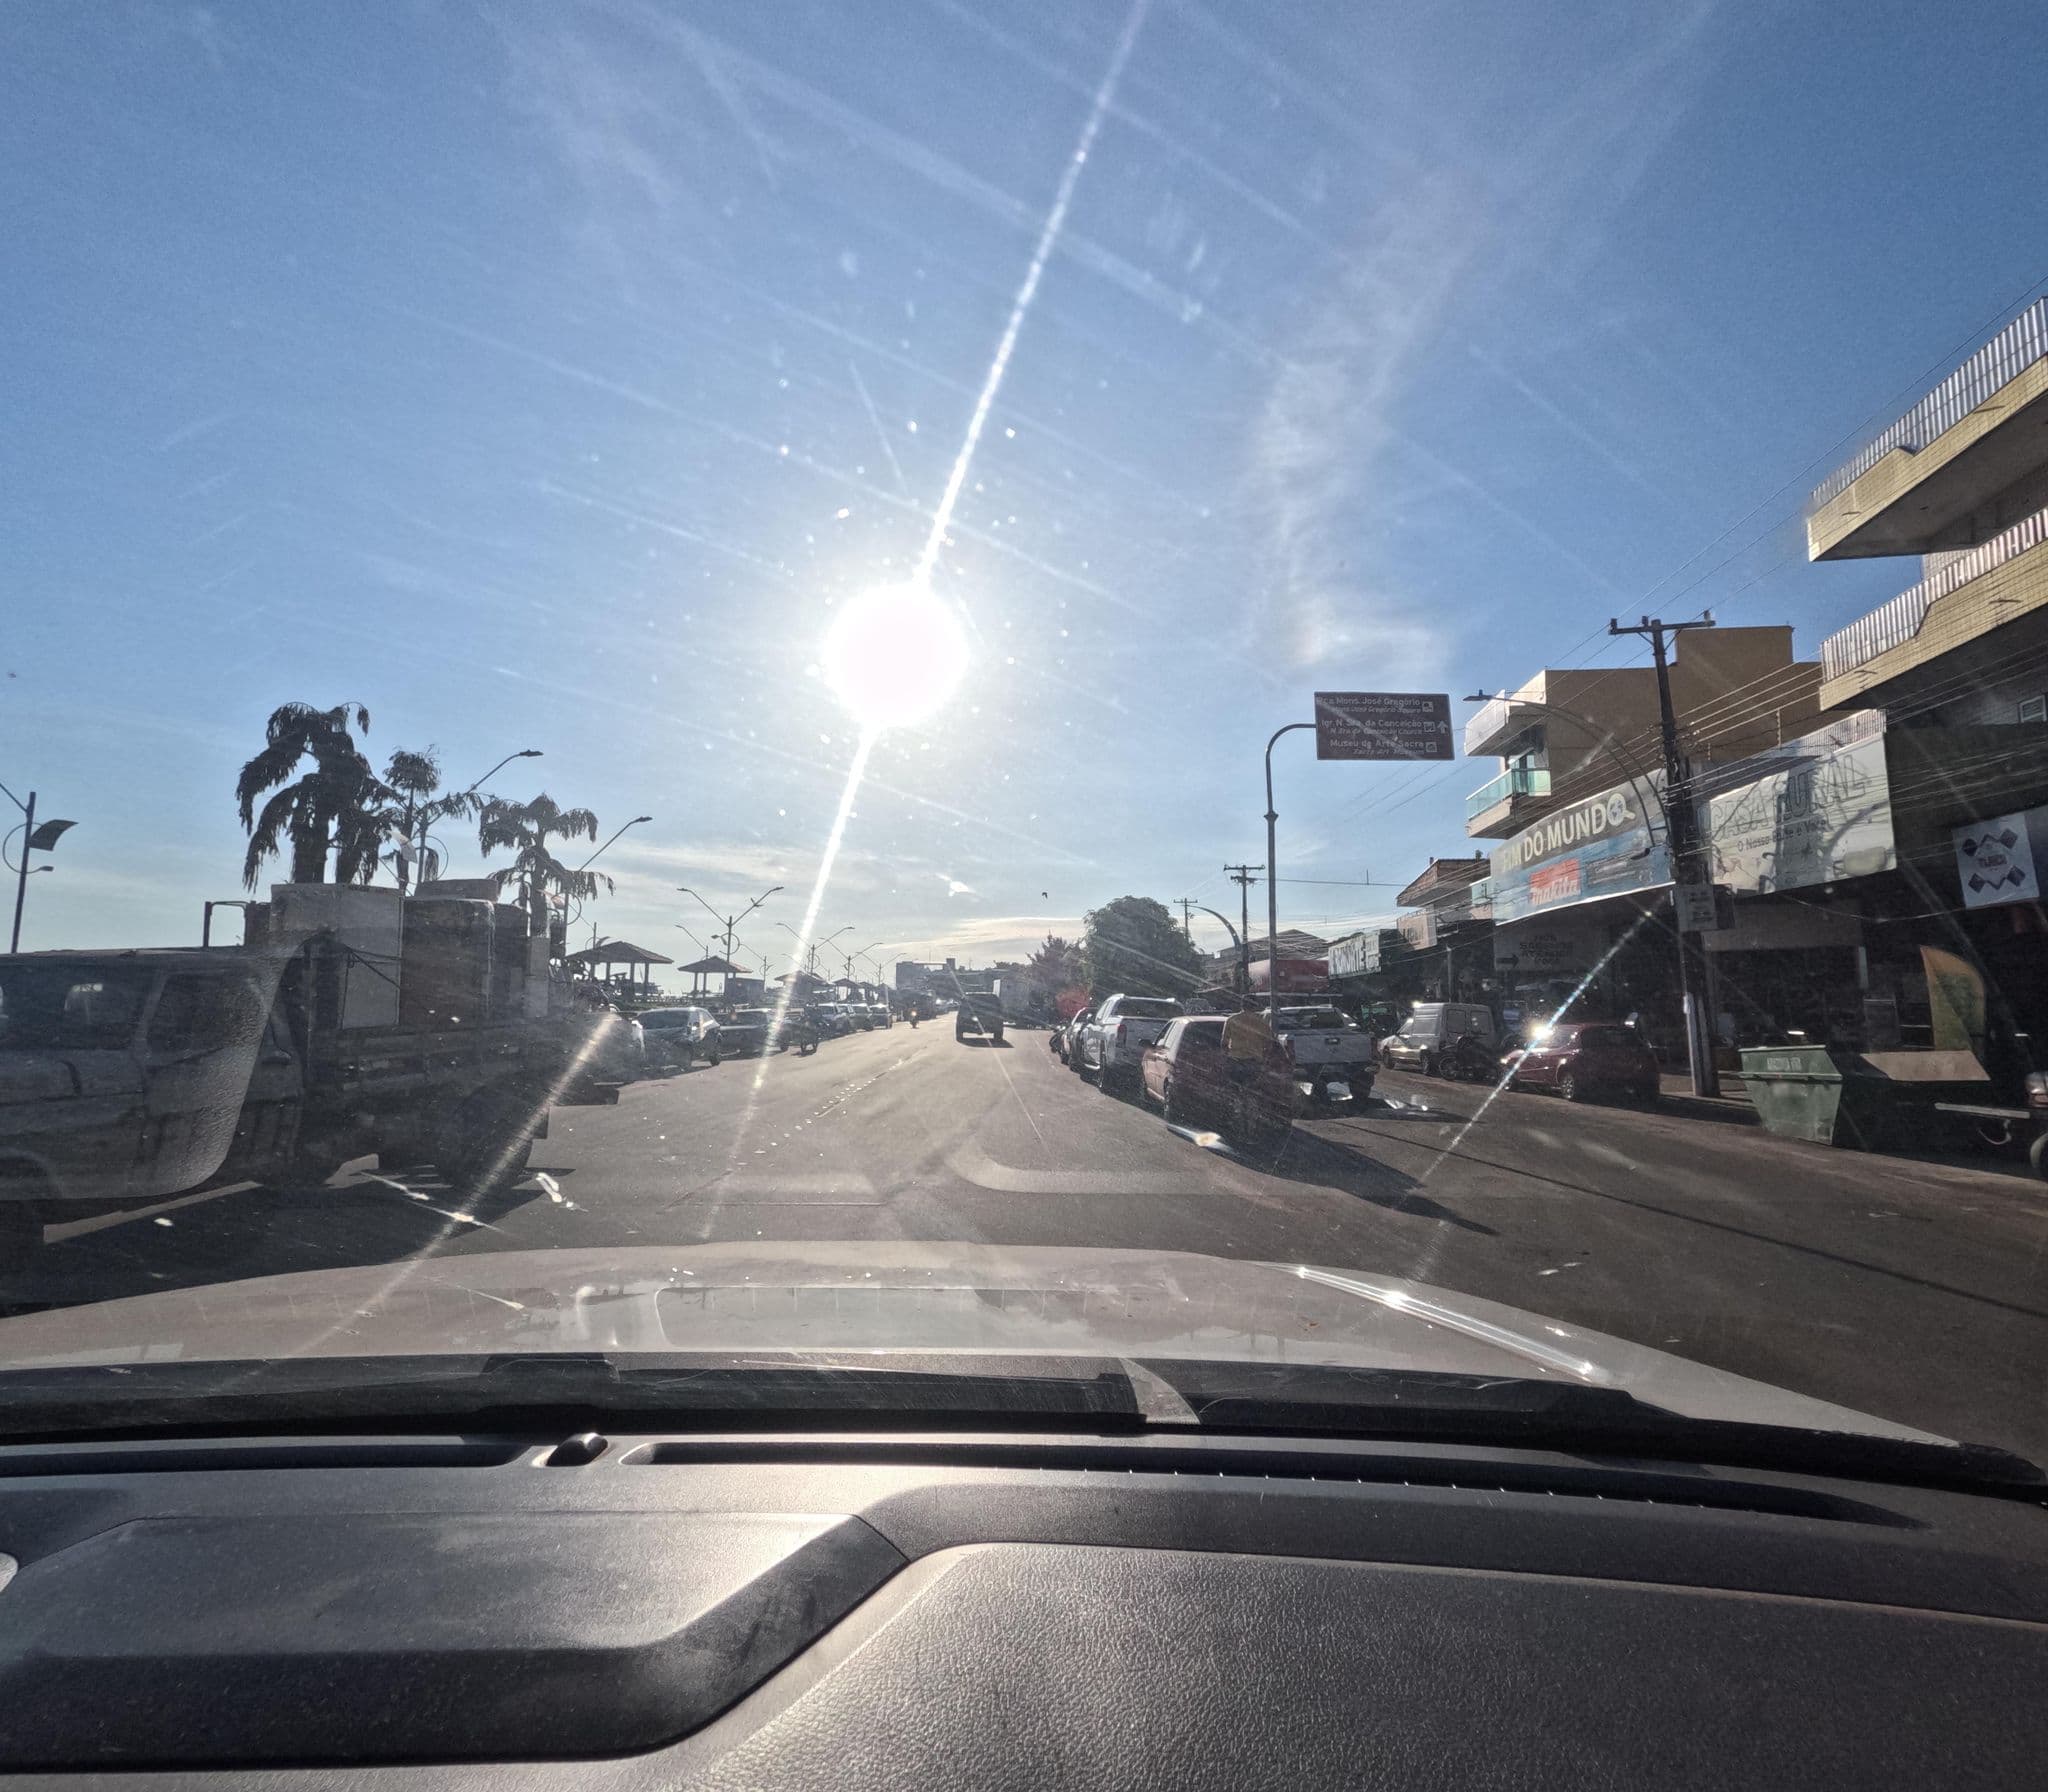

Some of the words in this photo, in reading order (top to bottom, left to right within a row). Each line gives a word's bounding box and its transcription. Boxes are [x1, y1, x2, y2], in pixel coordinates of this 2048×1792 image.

[1362, 696, 1382, 705] José
[1383, 697, 1421, 708] Gregório
[1378, 719, 1422, 729] Conceição
[1330, 739, 1359, 747] Museu
[1375, 739, 1396, 747] Arte
[1524, 831, 1544, 862] DO
[1547, 793, 1636, 851] MUNDO
[1737, 840, 1744, 852] O
[1746, 836, 1770, 850] Nosso
[1530, 876, 1581, 906] makita
